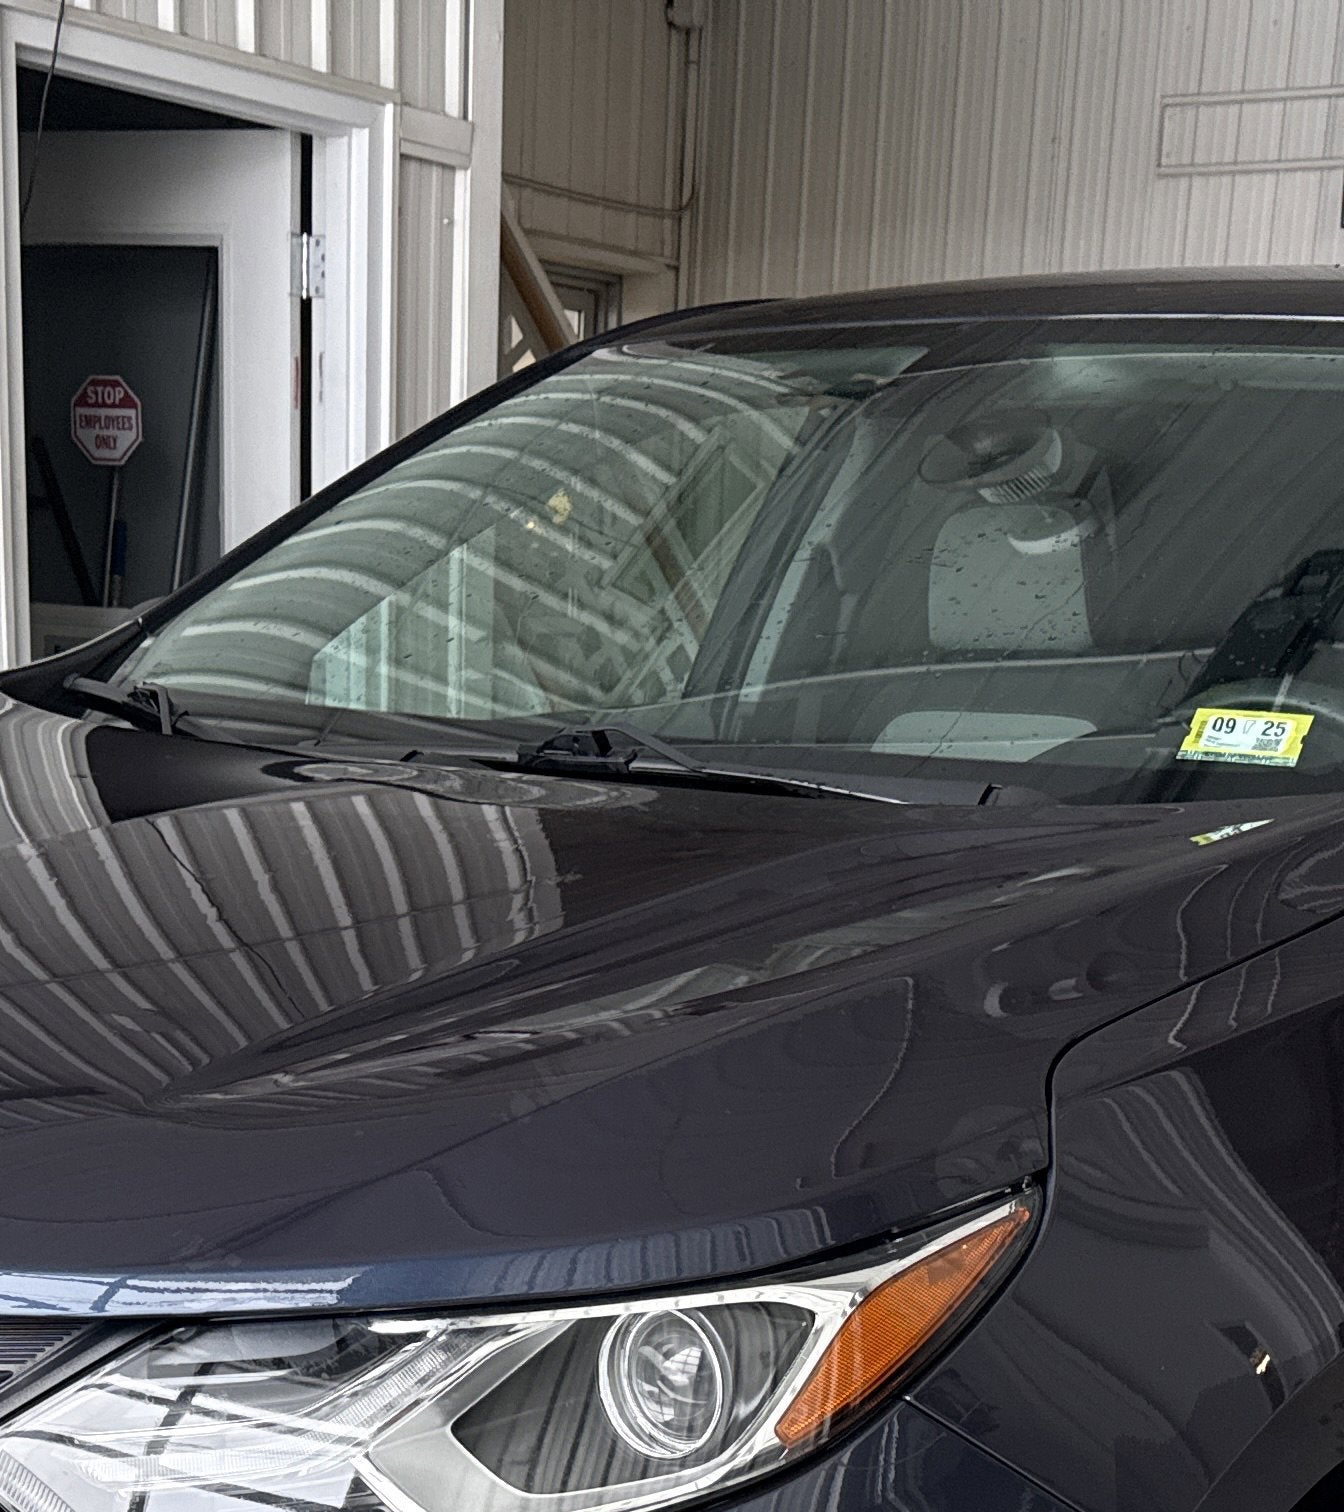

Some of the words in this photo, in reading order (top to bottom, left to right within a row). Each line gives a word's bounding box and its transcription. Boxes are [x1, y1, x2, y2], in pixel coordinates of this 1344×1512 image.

[86, 386, 125, 405] STOP
[79, 414, 133, 432] EMPLOYEES
[94, 434, 118, 450] ONLY
[1211, 716, 1237, 735] 09
[1261, 720, 1288, 737] 25
